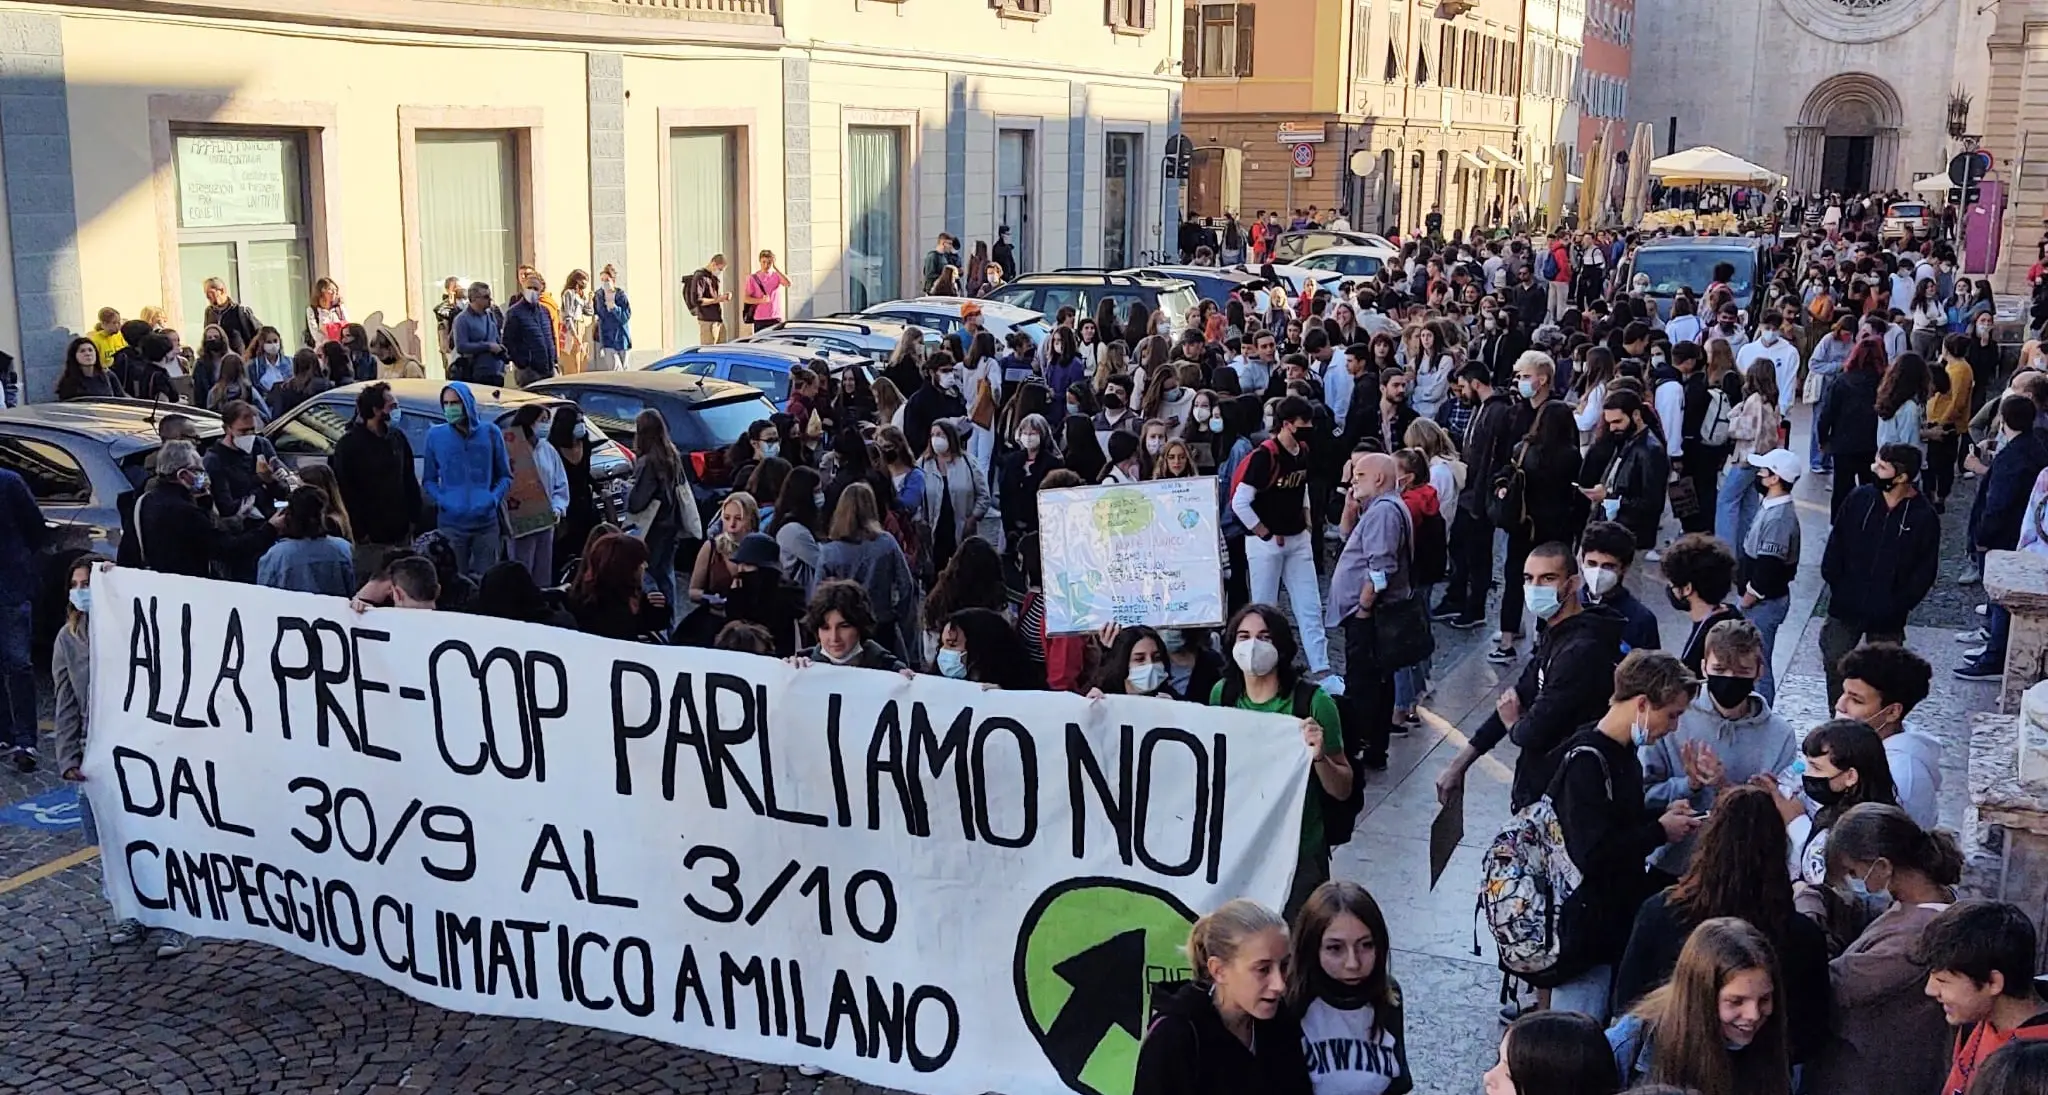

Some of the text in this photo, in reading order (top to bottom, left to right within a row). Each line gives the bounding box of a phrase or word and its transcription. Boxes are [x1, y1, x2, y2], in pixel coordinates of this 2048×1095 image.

[113, 746, 897, 943] DAL 30/9 AL 3/10
[124, 596, 252, 733] ALLA
[271, 617, 568, 782] PRE-COP
[1065, 723, 1226, 884] NOI
[125, 840, 365, 956] CAMPEGGIO
[373, 895, 654, 1016] CLIMATICO
[720, 952, 959, 1072] MILANO
